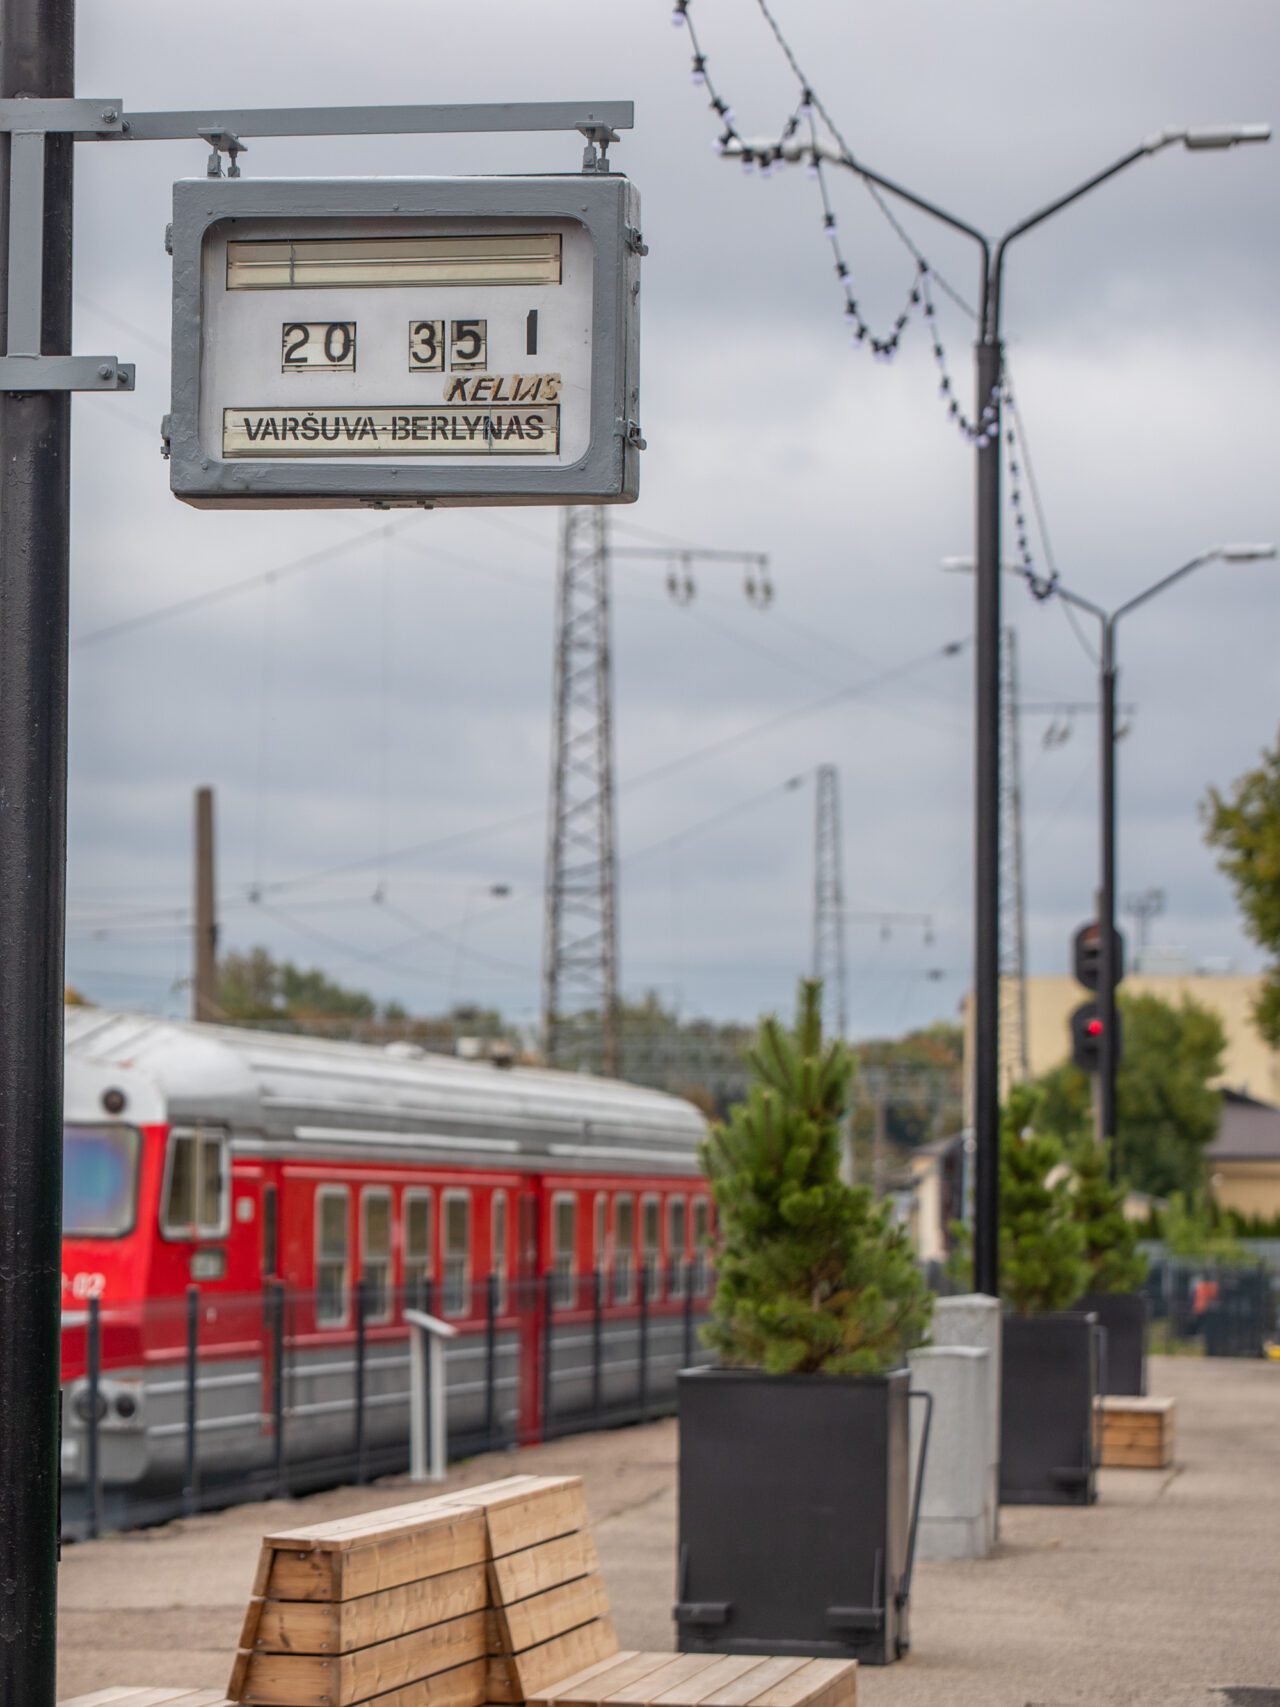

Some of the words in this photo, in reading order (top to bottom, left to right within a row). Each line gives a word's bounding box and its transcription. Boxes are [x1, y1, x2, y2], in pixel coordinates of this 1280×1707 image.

[284, 324, 352, 363] 20
[526, 309, 538, 355] 1
[447, 377, 561, 401] KELIAS
